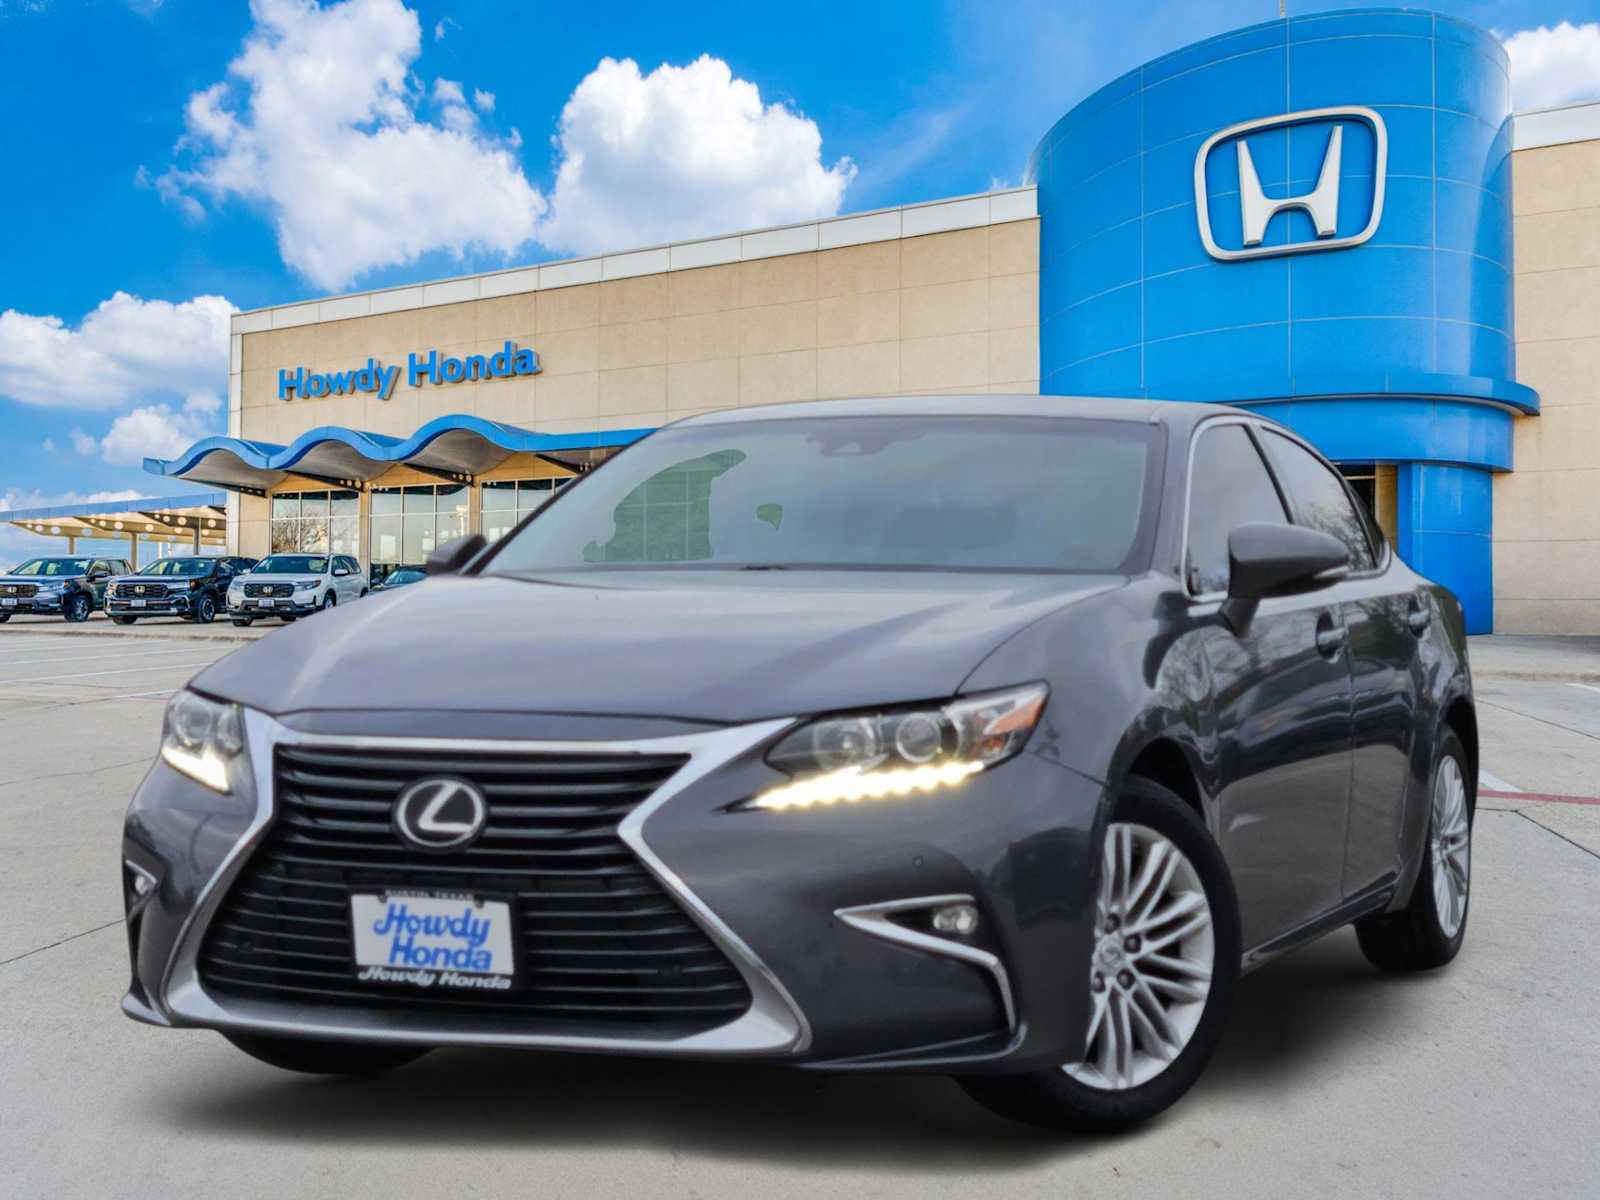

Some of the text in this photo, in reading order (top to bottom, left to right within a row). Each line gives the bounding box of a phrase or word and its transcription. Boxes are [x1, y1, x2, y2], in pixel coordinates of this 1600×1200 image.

[278, 340, 542, 401] Howdy Honda
[373, 903, 491, 946] Howdy
[389, 934, 492, 971] Honda
[358, 967, 511, 989] Howdy Honda
